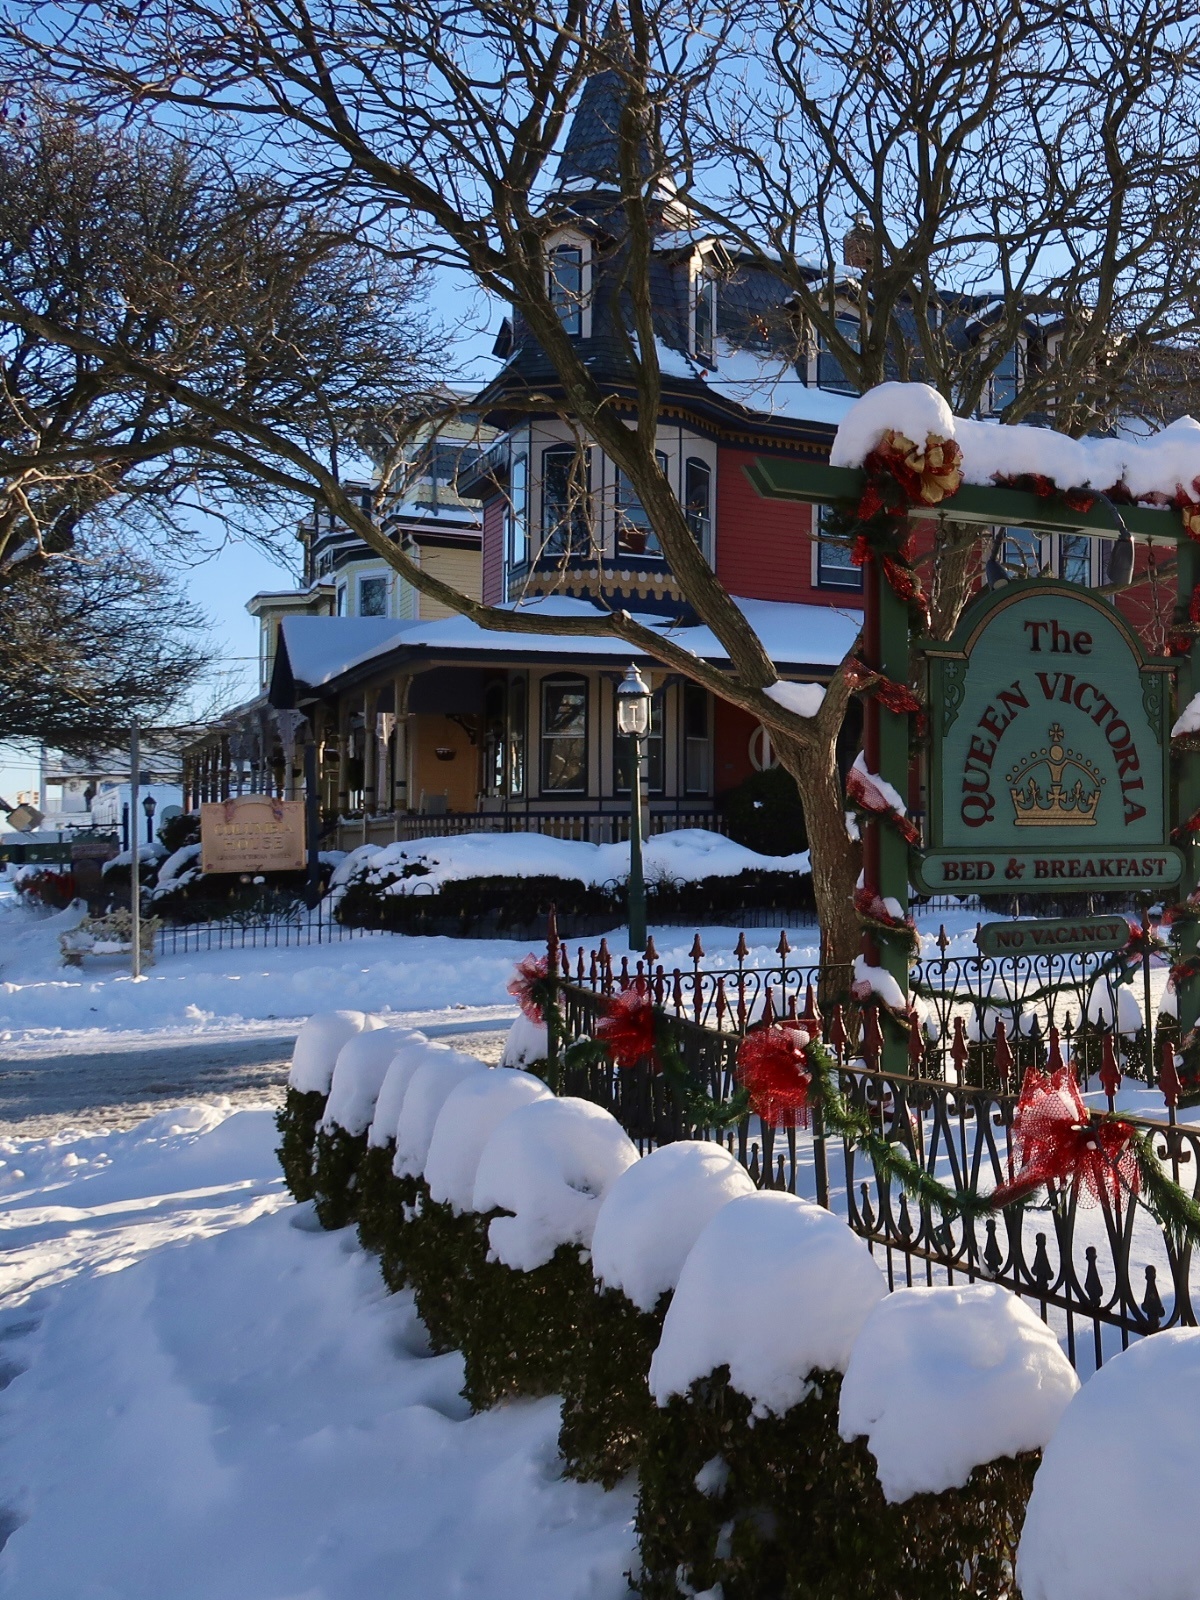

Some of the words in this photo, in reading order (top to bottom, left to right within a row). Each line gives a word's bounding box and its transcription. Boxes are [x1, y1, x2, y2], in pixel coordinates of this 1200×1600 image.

[1024, 620, 1093, 655] The
[960, 680, 1031, 828] QUEEN
[1034, 672, 1147, 827] VICTORIA
[223, 837, 284, 851] HOUSE
[942, 860, 995, 882] BED
[1004, 858, 1026, 880] &
[1033, 857, 1167, 879] BREAKFAST
[996, 931, 1025, 948] NO
[1029, 924, 1120, 945] VACANCY
